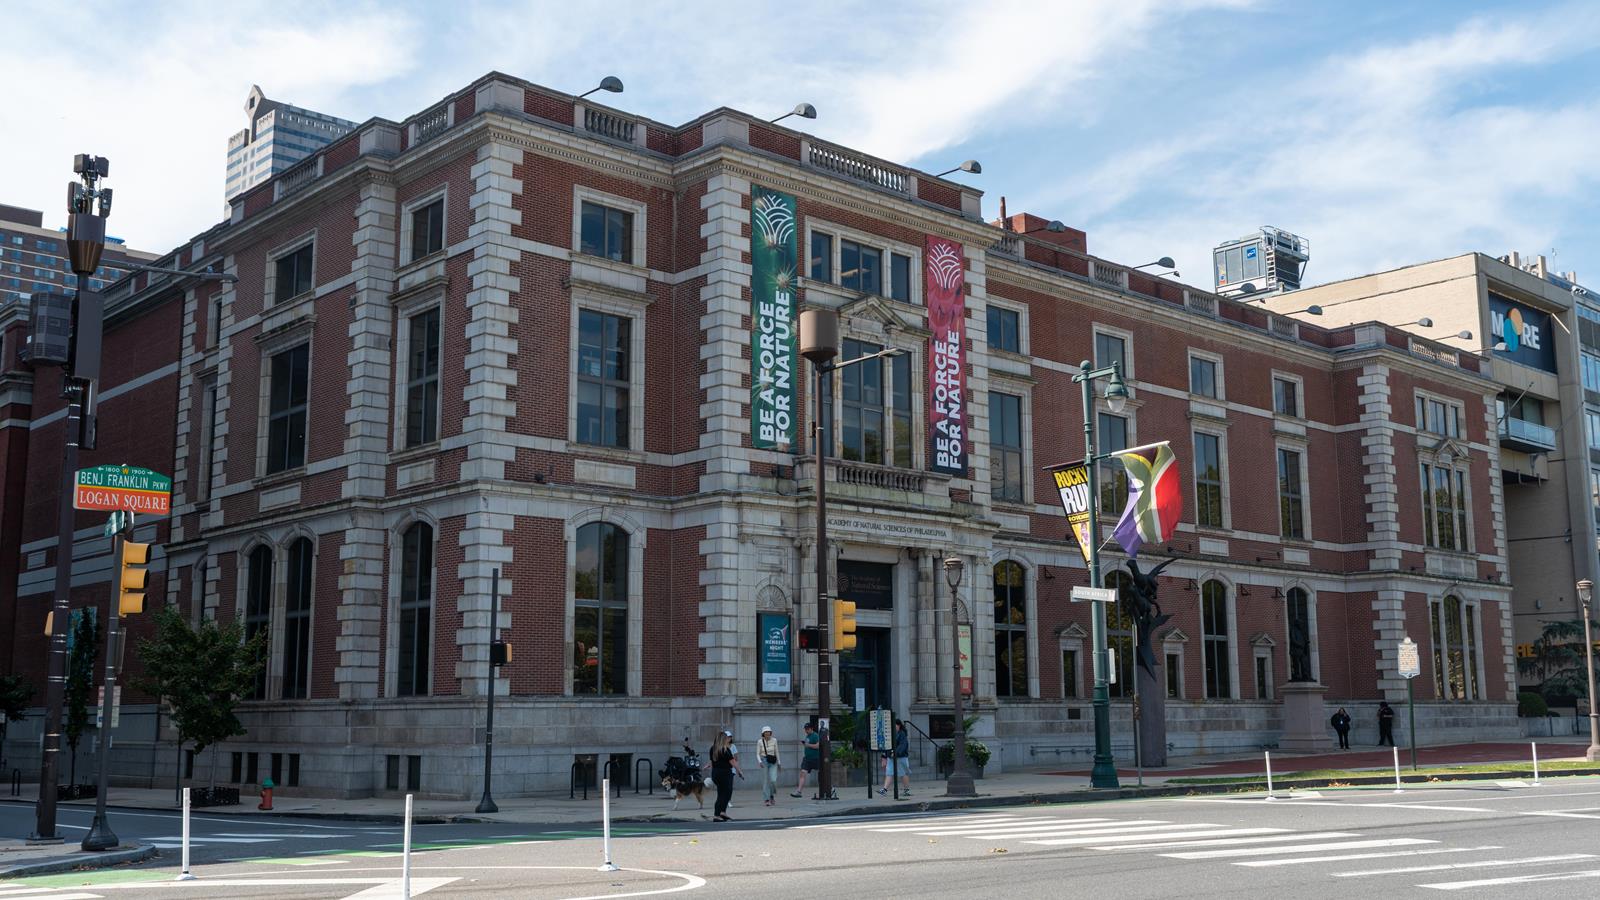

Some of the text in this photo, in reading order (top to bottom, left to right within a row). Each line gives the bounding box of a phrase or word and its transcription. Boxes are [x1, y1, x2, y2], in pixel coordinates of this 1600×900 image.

[759, 301, 775, 442] BE A FORCE
[775, 290, 791, 445] FOR NATURE
[935, 340, 949, 467] BE A FORCE
[947, 330, 962, 470] FOR NATURE
[79, 491, 167, 511] LOGAN SQUARE
[80, 471, 168, 490] BENJ FRANKLIN PKWY
[1054, 466, 1089, 489] ROCKY
[826, 518, 852, 527] ACADEMY
[852, 520, 860, 528] OF
[860, 521, 881, 531] NATURAL
[883, 524, 907, 533] SCIENCES
[914, 528, 948, 537] PHILADELPHIA
